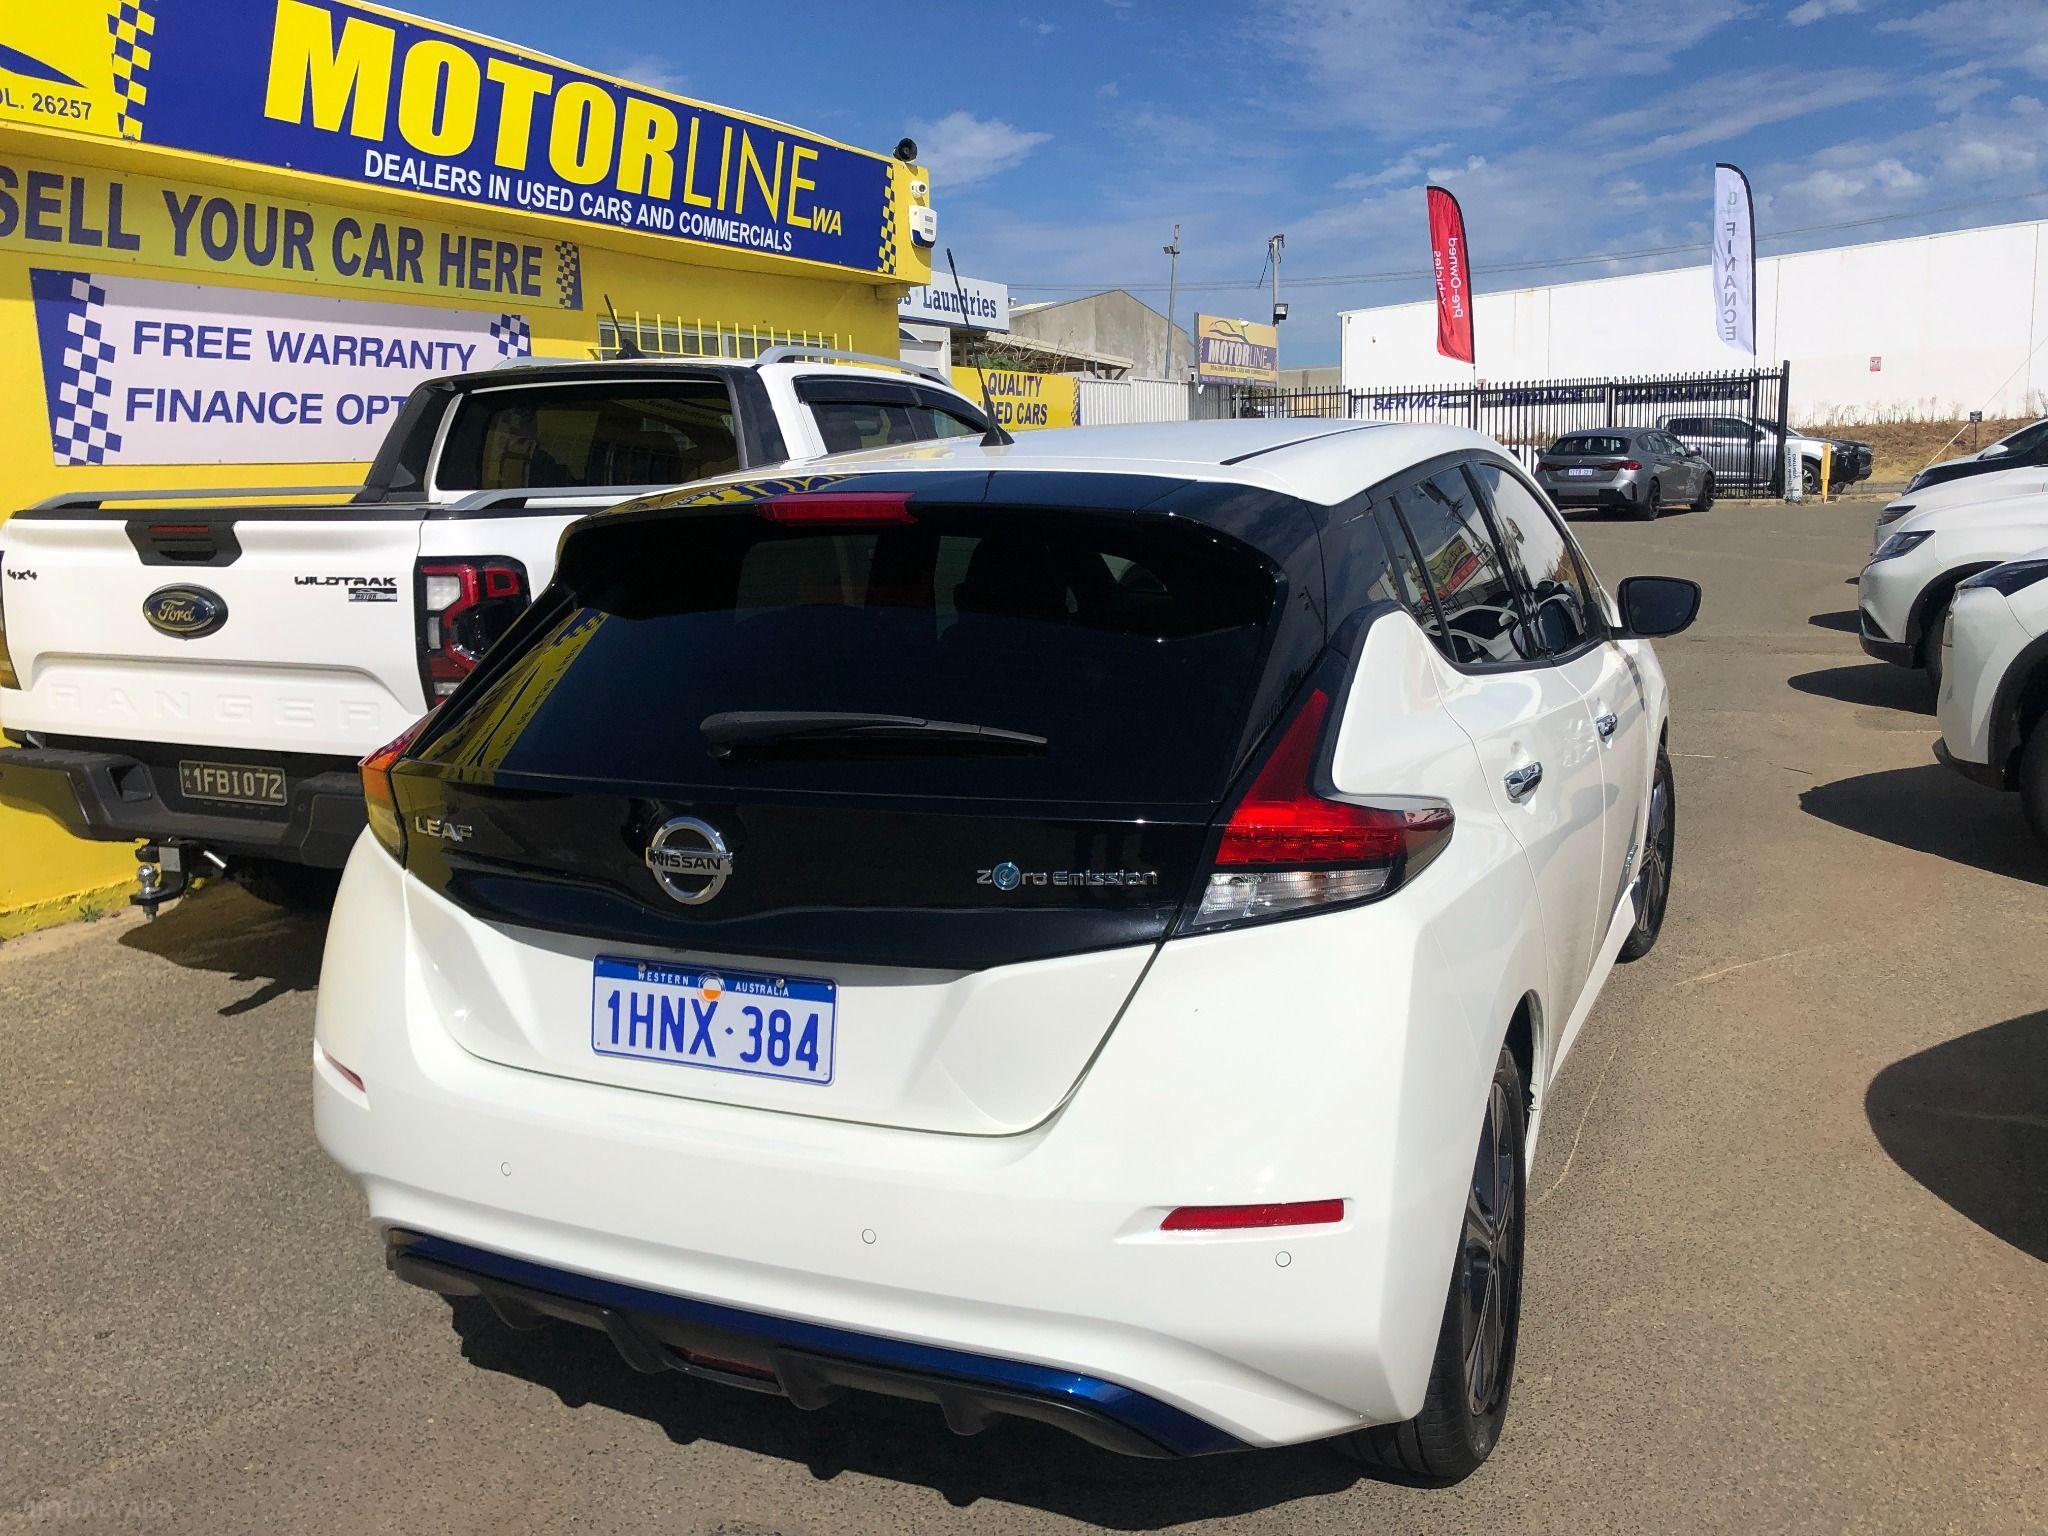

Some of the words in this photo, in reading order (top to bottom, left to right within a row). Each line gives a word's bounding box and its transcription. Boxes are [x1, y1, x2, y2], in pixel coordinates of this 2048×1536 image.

[0, 87, 24, 109] L.
[31, 92, 92, 120] 26257
[264, 0, 818, 229] MOTORLINE
[813, 206, 842, 237] WA
[364, 149, 481, 197] DEALERS
[488, 174, 511, 202] IN
[516, 181, 574, 212] USED
[579, 192, 633, 225] CARS
[637, 205, 675, 231] AND
[679, 212, 793, 253] COMMERCIALS
[0, 165, 140, 251] SELL
[162, 190, 315, 272] YOUR
[332, 217, 424, 284] CAR
[438, 232, 543, 297] HERE
[922, 285, 997, 319] Laundries
[133, 321, 252, 361] FREE
[266, 330, 478, 373] WARRANTY
[1207, 339, 1268, 370] MOTORLINE
[988, 372, 1043, 398] QUALITY
[125, 387, 323, 426] FINANCE
[1016, 402, 1048, 425] CARS
[294, 576, 397, 587] WILDTRAK
[157, 599, 196, 622] Ford
[46, 681, 384, 731] RANGER
[415, 815, 473, 842] LEAF
[653, 850, 720, 870] NISSAN
[1053, 869, 1158, 887] Emission
[637, 971, 689, 986] WESTERN
[735, 981, 790, 997] AUSTRALIA
